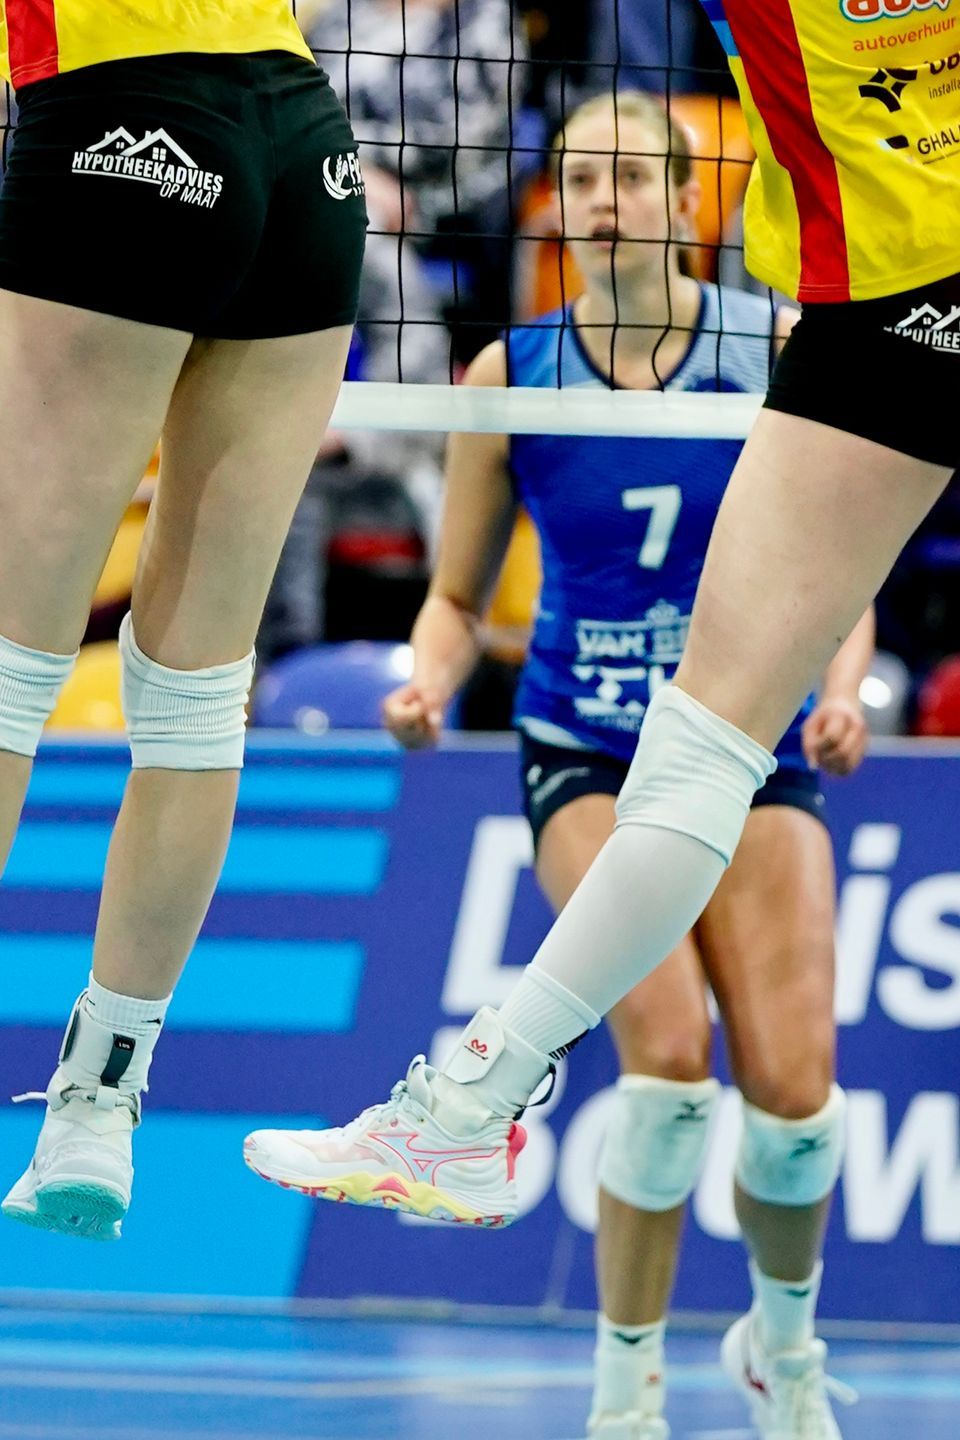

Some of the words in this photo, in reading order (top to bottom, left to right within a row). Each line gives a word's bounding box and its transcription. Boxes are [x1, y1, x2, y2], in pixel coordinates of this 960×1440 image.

[853, 17, 957, 52] autoverhuur
[917, 124, 960, 155] GHAL
[71, 151, 224, 195] HYPOTHEEKADVIES
[159, 181, 180, 199] OP
[180, 186, 221, 209] MAAT
[622, 484, 683, 570] 7
